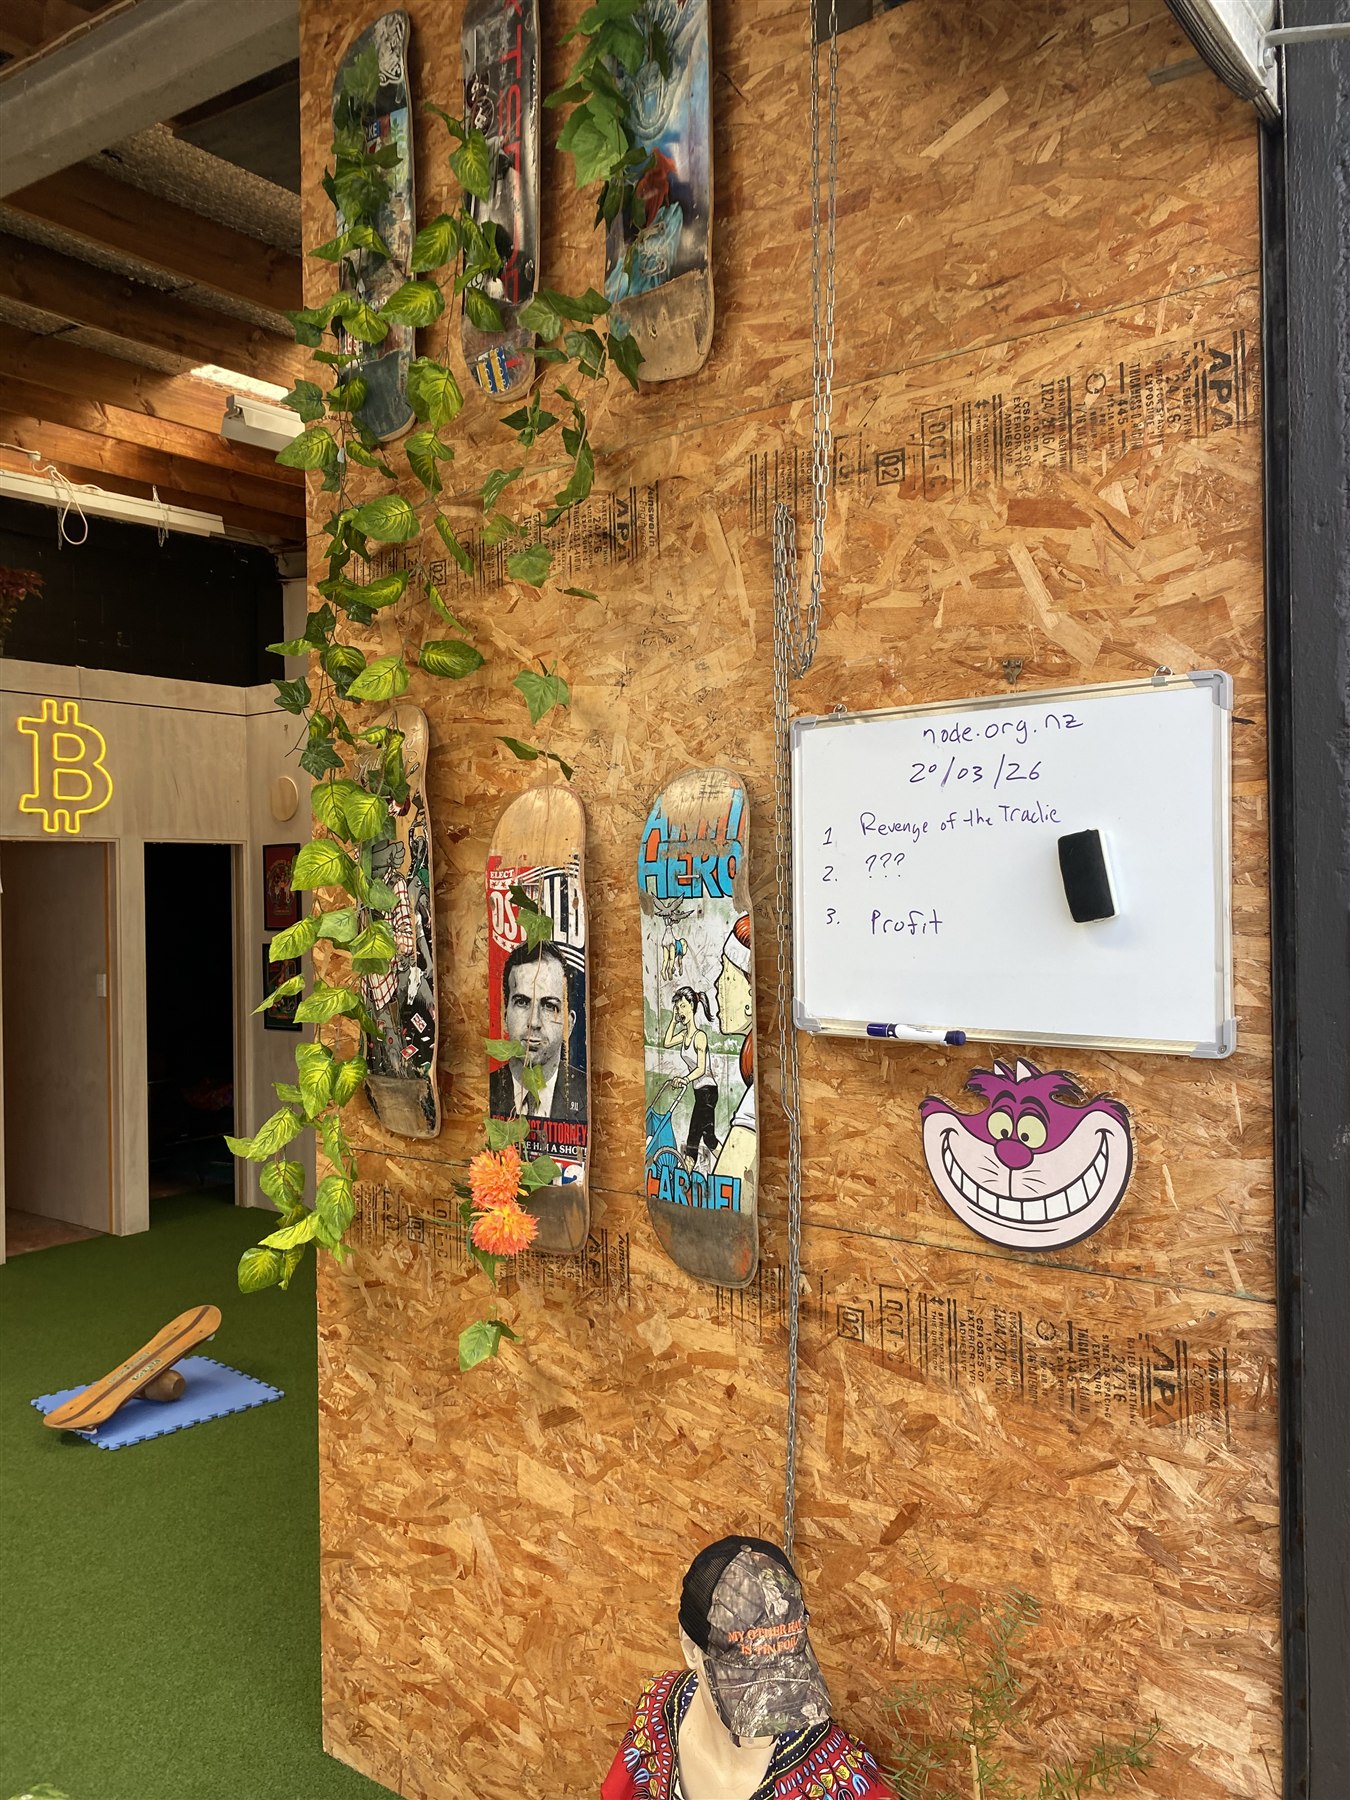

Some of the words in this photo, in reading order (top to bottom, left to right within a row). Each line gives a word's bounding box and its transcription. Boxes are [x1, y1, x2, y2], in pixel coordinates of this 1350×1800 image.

[1128, 363, 1140, 410] THICKNESS
[1145, 374, 1154, 426] EXPOSURE
[1209, 348, 1233, 432] APA
[1013, 397, 1021, 450] EXTERIOR
[1022, 402, 1030, 422] CSA
[1057, 379, 1066, 432] CONSTRUCTION
[1117, 399, 1128, 425] 445
[1004, 414, 1012, 464] ADHESIVE
[880, 455, 903, 480] 02
[616, 499, 630, 562] APA
[922, 712, 1084, 746] node.org.nz
[641, 785, 744, 844] AI
[859, 811, 928, 844] Revenge
[940, 812, 959, 832] of
[963, 808, 993, 827] the
[489, 869, 515, 880] ELECT
[637, 838, 744, 899] HERO
[822, 865, 839, 883] 2.
[865, 852, 906, 879] ???
[489, 875, 586, 950] OSLD
[826, 908, 840, 926] 3.
[870, 909, 943, 936] Profit
[543, 1121, 587, 1146] ATTORNEY
[550, 1144, 558, 1153] A
[841, 1311, 859, 1336] 02
[967, 1310, 975, 1360] EXTERIOR
[976, 1318, 984, 1338] CSA
[1127, 1337, 1135, 1368] RATED
[1112, 1354, 1127, 1403] 24/16
[1103, 1381, 1111, 1418] SPACING
[1128, 1373, 1137, 1426] SHEATHING
[727, 1631, 745, 1643] MY
[747, 1624, 787, 1640] OTHER
[740, 1643, 753, 1656] IS
